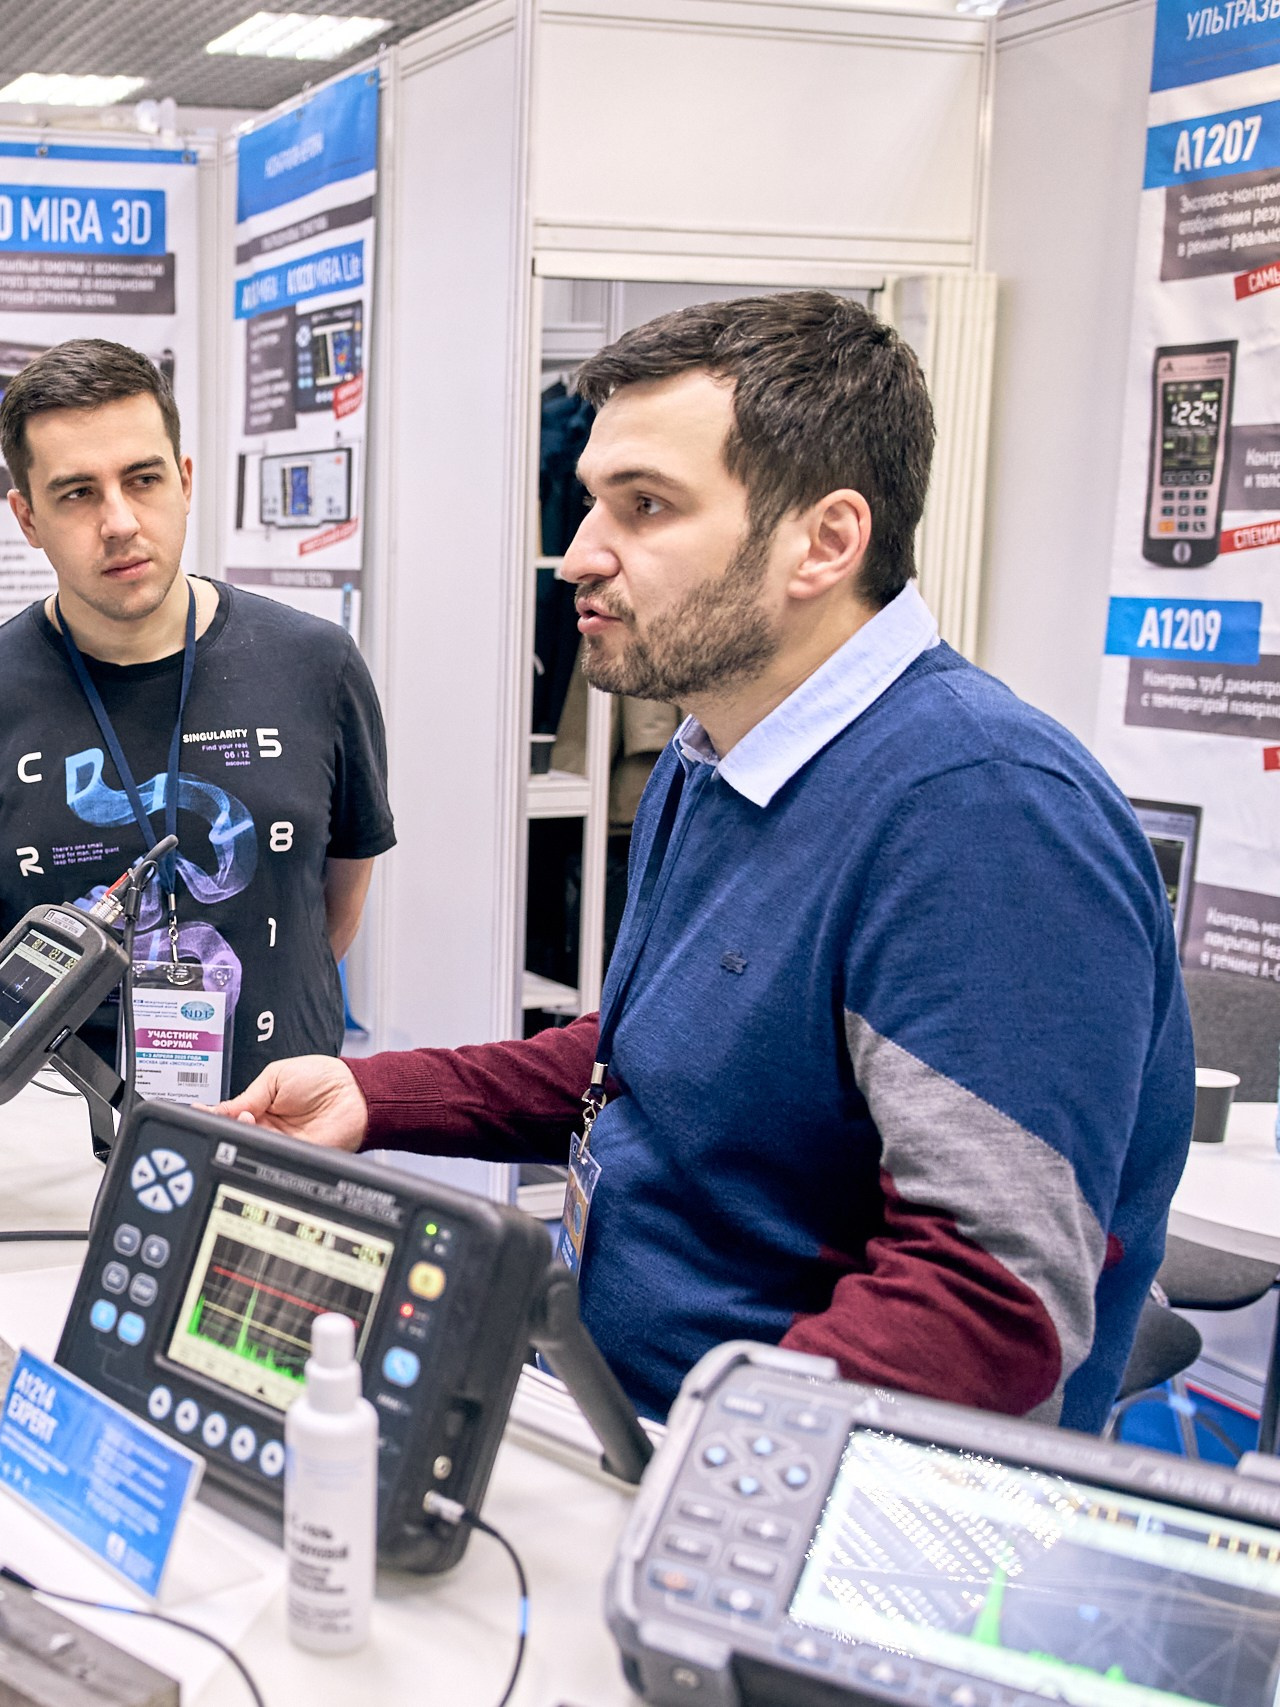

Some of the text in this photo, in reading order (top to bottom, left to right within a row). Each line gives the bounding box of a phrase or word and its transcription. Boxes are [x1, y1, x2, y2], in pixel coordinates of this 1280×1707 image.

[1174, 115, 1262, 174] A1207
[20, 197, 104, 244] MIRA
[112, 200, 151, 245] 3D
[1137, 606, 1221, 652] A1209
[1142, 668, 1198, 692] Контроль
[182, 728, 247, 743] SINGULARITY
[256, 728, 282, 758] 5
[16, 752, 42, 784] C
[269, 821, 294, 853] 8
[16, 846, 44, 877] R
[147, 1030, 199, 1040] УЧАСТНИК
[256, 1010, 275, 1043] 9
[152, 1040, 193, 1048] ФОРУМА
[6, 1392, 59, 1444] EXPERT
